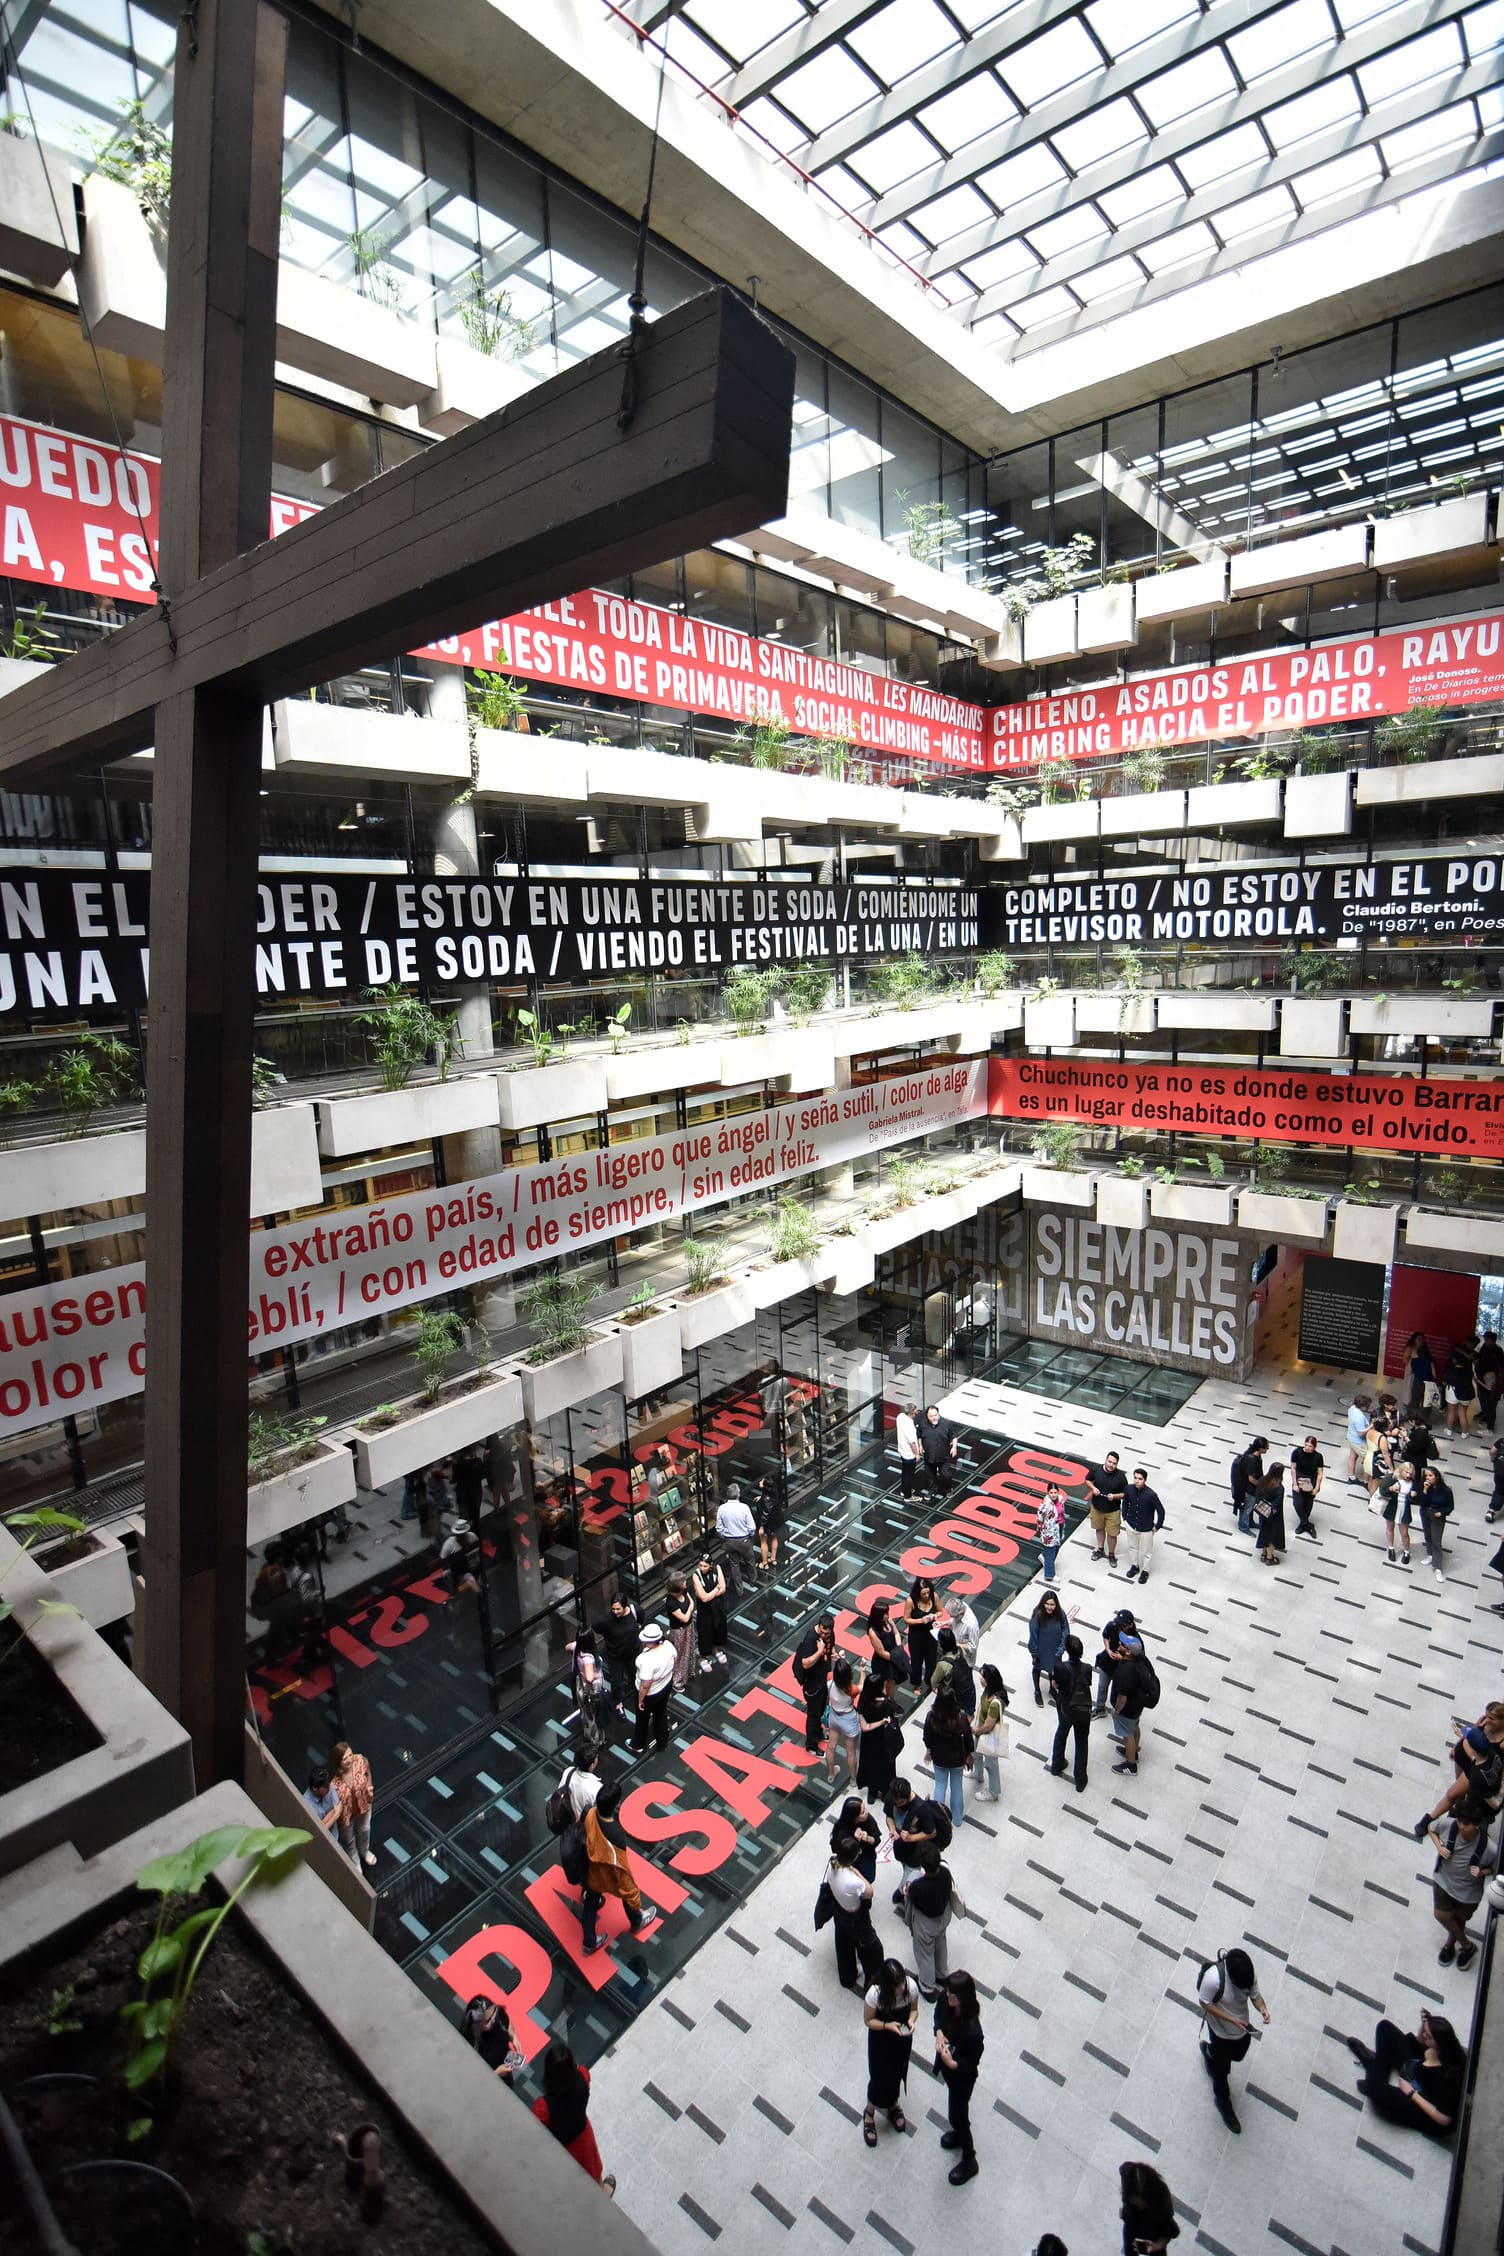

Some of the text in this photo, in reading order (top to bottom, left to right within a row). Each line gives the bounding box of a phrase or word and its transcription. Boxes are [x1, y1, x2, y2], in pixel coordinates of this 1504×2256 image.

[592, 594, 662, 650] TODA
[669, 616, 698, 660] LA
[702, 625, 754, 673] VIDA
[758, 643, 879, 706] SANTIAGUINA.
[883, 678, 907, 712] LES
[909, 691, 984, 733] MANDARINS
[993, 621, 1500, 737] CHILENO. ASADOS AL PALO, RAYU
[1408, 667, 1481, 684] José Donoso.
[1408, 685, 1421, 694] En
[1424, 683, 1438, 692] De
[1441, 677, 1479, 689] Diarios
[482, 620, 606, 686] FIESTAS
[615, 650, 649, 695] DE
[794, 694, 857, 740] SOCIAL
[860, 711, 930, 755] CLIMBING
[970, 738, 984, 766] EL
[1450, 690, 1460, 698] in
[993, 723, 1111, 766] CLIMBING
[1121, 707, 1207, 748] HACIA
[1217, 701, 1251, 733] EL
[1263, 682, 1383, 727] PODER.
[71, 882, 146, 938] EL
[360, 881, 376, 934] /
[395, 884, 515, 929] ESTOY
[528, 886, 569, 926] EN
[581, 887, 642, 925] UNA
[651, 888, 745, 924] FUENTE
[753, 889, 780, 922] DE
[786, 889, 837, 921] SODA
[843, 888, 851, 922] /
[858, 886, 957, 920] COMIÉNDOME
[961, 892, 978, 918] UN
[1005, 860, 1504, 915] COMPLETO / NO ESTOY EN EL PO
[1342, 899, 1485, 917] Claudio Bertoni.
[1005, 905, 1326, 944] TELEVISOR MOTOROLA.
[1342, 921, 1364, 933] De
[1434, 919, 1455, 931] en
[364, 936, 420, 986] DE
[435, 934, 536, 980] SODA
[549, 930, 563, 976] /
[576, 928, 684, 970] VIENDO
[694, 929, 722, 964] EL
[731, 925, 830, 961] FESTIVAL
[836, 925, 859, 954] DE
[864, 923, 884, 952] LA
[889, 923, 922, 949] UNA
[926, 921, 934, 950] /
[938, 921, 956, 948] EN
[961, 921, 978, 947] UN
[1019, 1064, 1129, 1089] Chuchunco
[1135, 1073, 1160, 1094] ya
[1166, 1076, 1193, 1093] no
[1200, 1078, 1226, 1095] es
[1233, 1075, 1308, 1100] donde
[1316, 1082, 1405, 1106] estuvo
[868, 1106, 925, 1131] Gabriela Mistral.
[869, 1133, 879, 1144] De
[900, 1123, 908, 1134] de
[909, 1121, 915, 1131] la
[948, 1109, 956, 1120] en
[1019, 1094, 1476, 1145] es un lugar deshabitado como el olvido.
[263, 1067, 968, 1278] extraño país, / más ligero que ángel / y seña sutil, / color de alga
[338, 1270, 346, 1316] /
[361, 1258, 427, 1303] con
[438, 1223, 516, 1278] edad
[526, 1215, 560, 1250] de
[568, 1186, 674, 1239] siempre,
[680, 1172, 687, 1206] /
[693, 1166, 724, 1199] sin
[730, 1149, 776, 1188] edad
[780, 1139, 820, 1172] feliz.
[1036, 1213, 1240, 1308] SIEMPRE
[1036, 1276, 1096, 1335] LAS
[1104, 1290, 1237, 1365] CALLES
